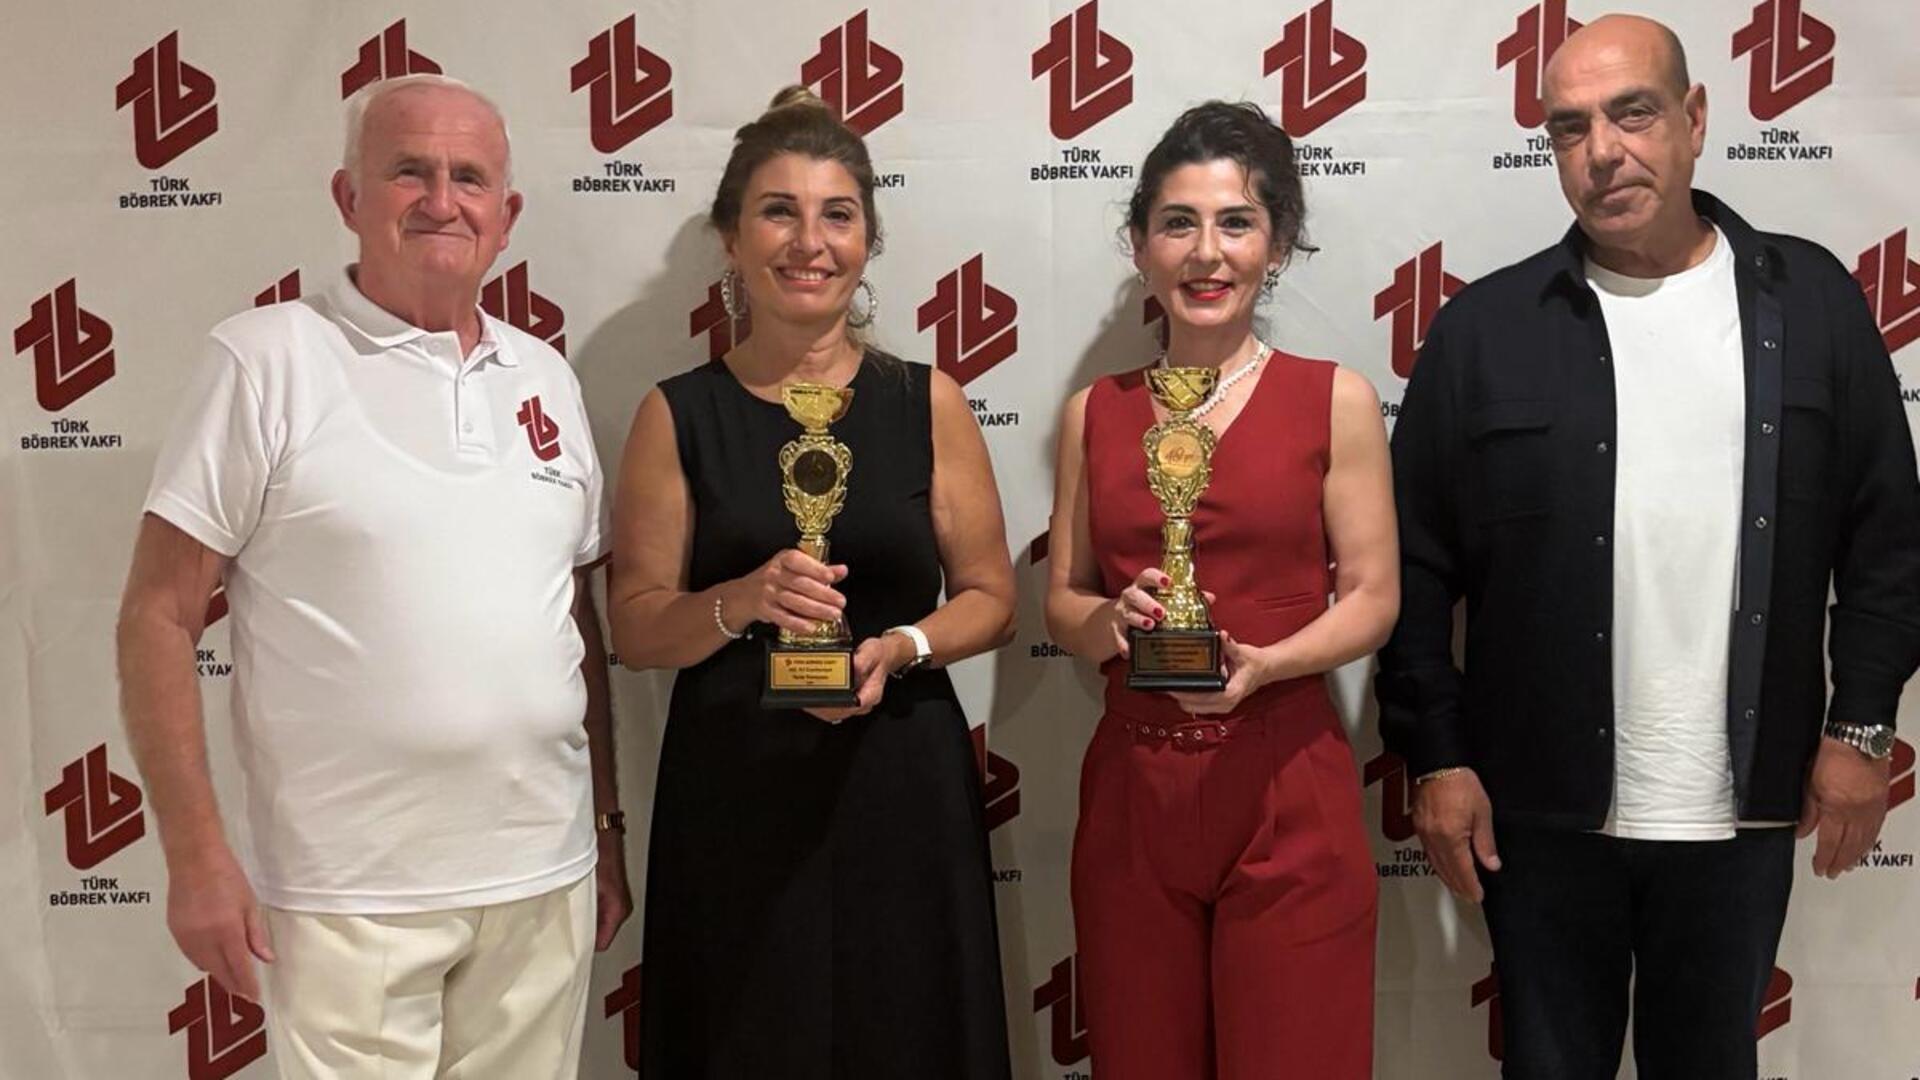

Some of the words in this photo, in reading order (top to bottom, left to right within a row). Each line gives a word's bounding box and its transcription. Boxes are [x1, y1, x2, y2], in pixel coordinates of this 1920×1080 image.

[1760, 128, 1799, 144] TÜRK
[1061, 147, 1100, 163] TÜRK
[1727, 144, 1786, 160] BÖBREK
[1789, 146, 1832, 159] VAKFI
[1493, 152, 1553, 168] BÖBREK
[604, 161, 642, 176] TÜRK
[1031, 164, 1088, 180] BÖBREK
[1091, 165, 1133, 178] VAKFI
[1322, 162, 1365, 176] VAKFI
[150, 176, 190, 192] TÜRK
[573, 176, 631, 192] BÖBREK
[633, 179, 675, 192] VAKFI
[872, 174, 904, 188] AKFI
[119, 193, 178, 208] BÖBREK
[180, 192, 222, 206] VAKFI
[968, 399, 987, 412] RK
[51, 418, 89, 433] TÜRK
[978, 412, 1018, 426] VAKFI
[21, 434, 78, 449] BÖBREK
[80, 435, 121, 448] VAKFI
[197, 649, 216, 662] RK
[1872, 854, 1913, 867] VAKFI
[81, 876, 118, 891] TÜRK
[992, 870, 1022, 882] AKFI
[50, 892, 107, 906] BÖBREK
[109, 892, 150, 904] VAKFI
